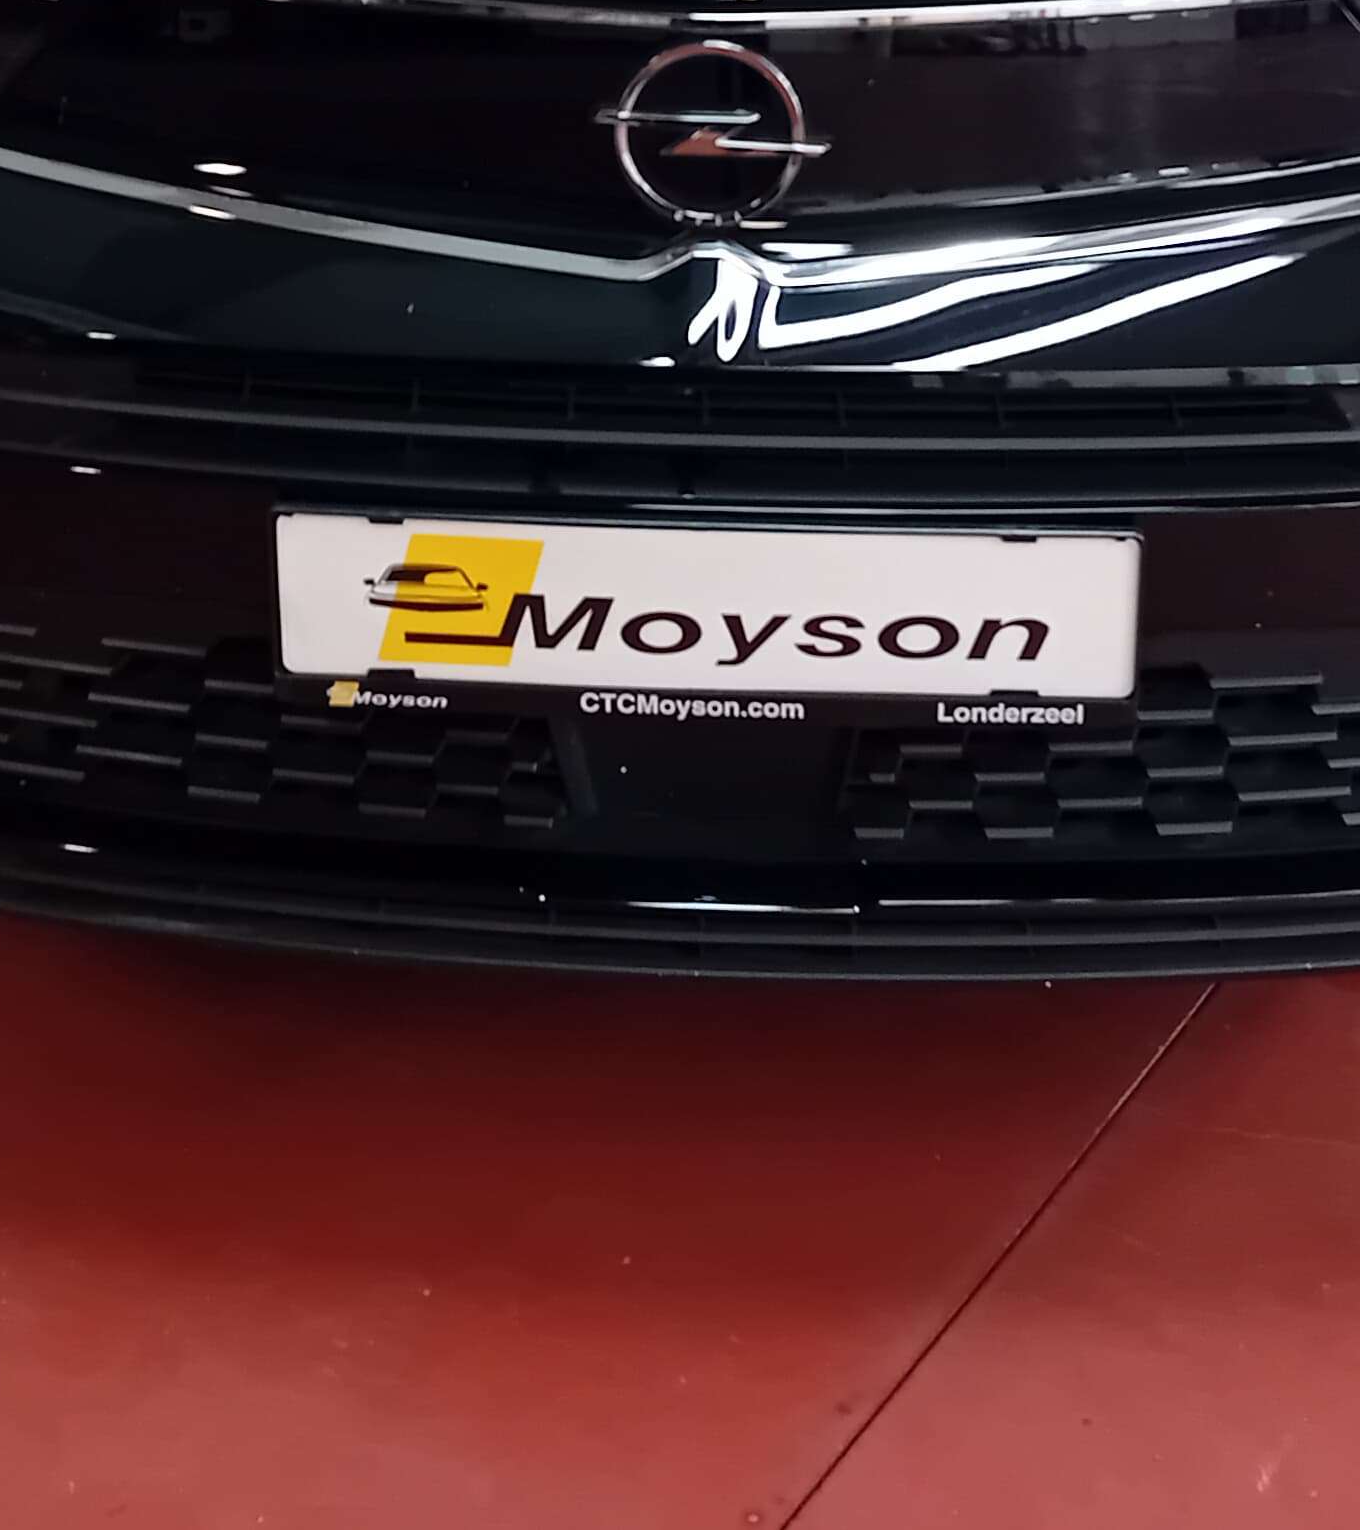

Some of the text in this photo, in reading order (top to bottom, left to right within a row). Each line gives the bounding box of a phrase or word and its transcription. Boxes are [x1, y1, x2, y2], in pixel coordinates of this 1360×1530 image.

[498, 593, 1051, 667] Moyson
[353, 689, 449, 709] Moyson
[579, 692, 805, 721] CTCMoyson.com
[937, 701, 1084, 725] Londerzeel
